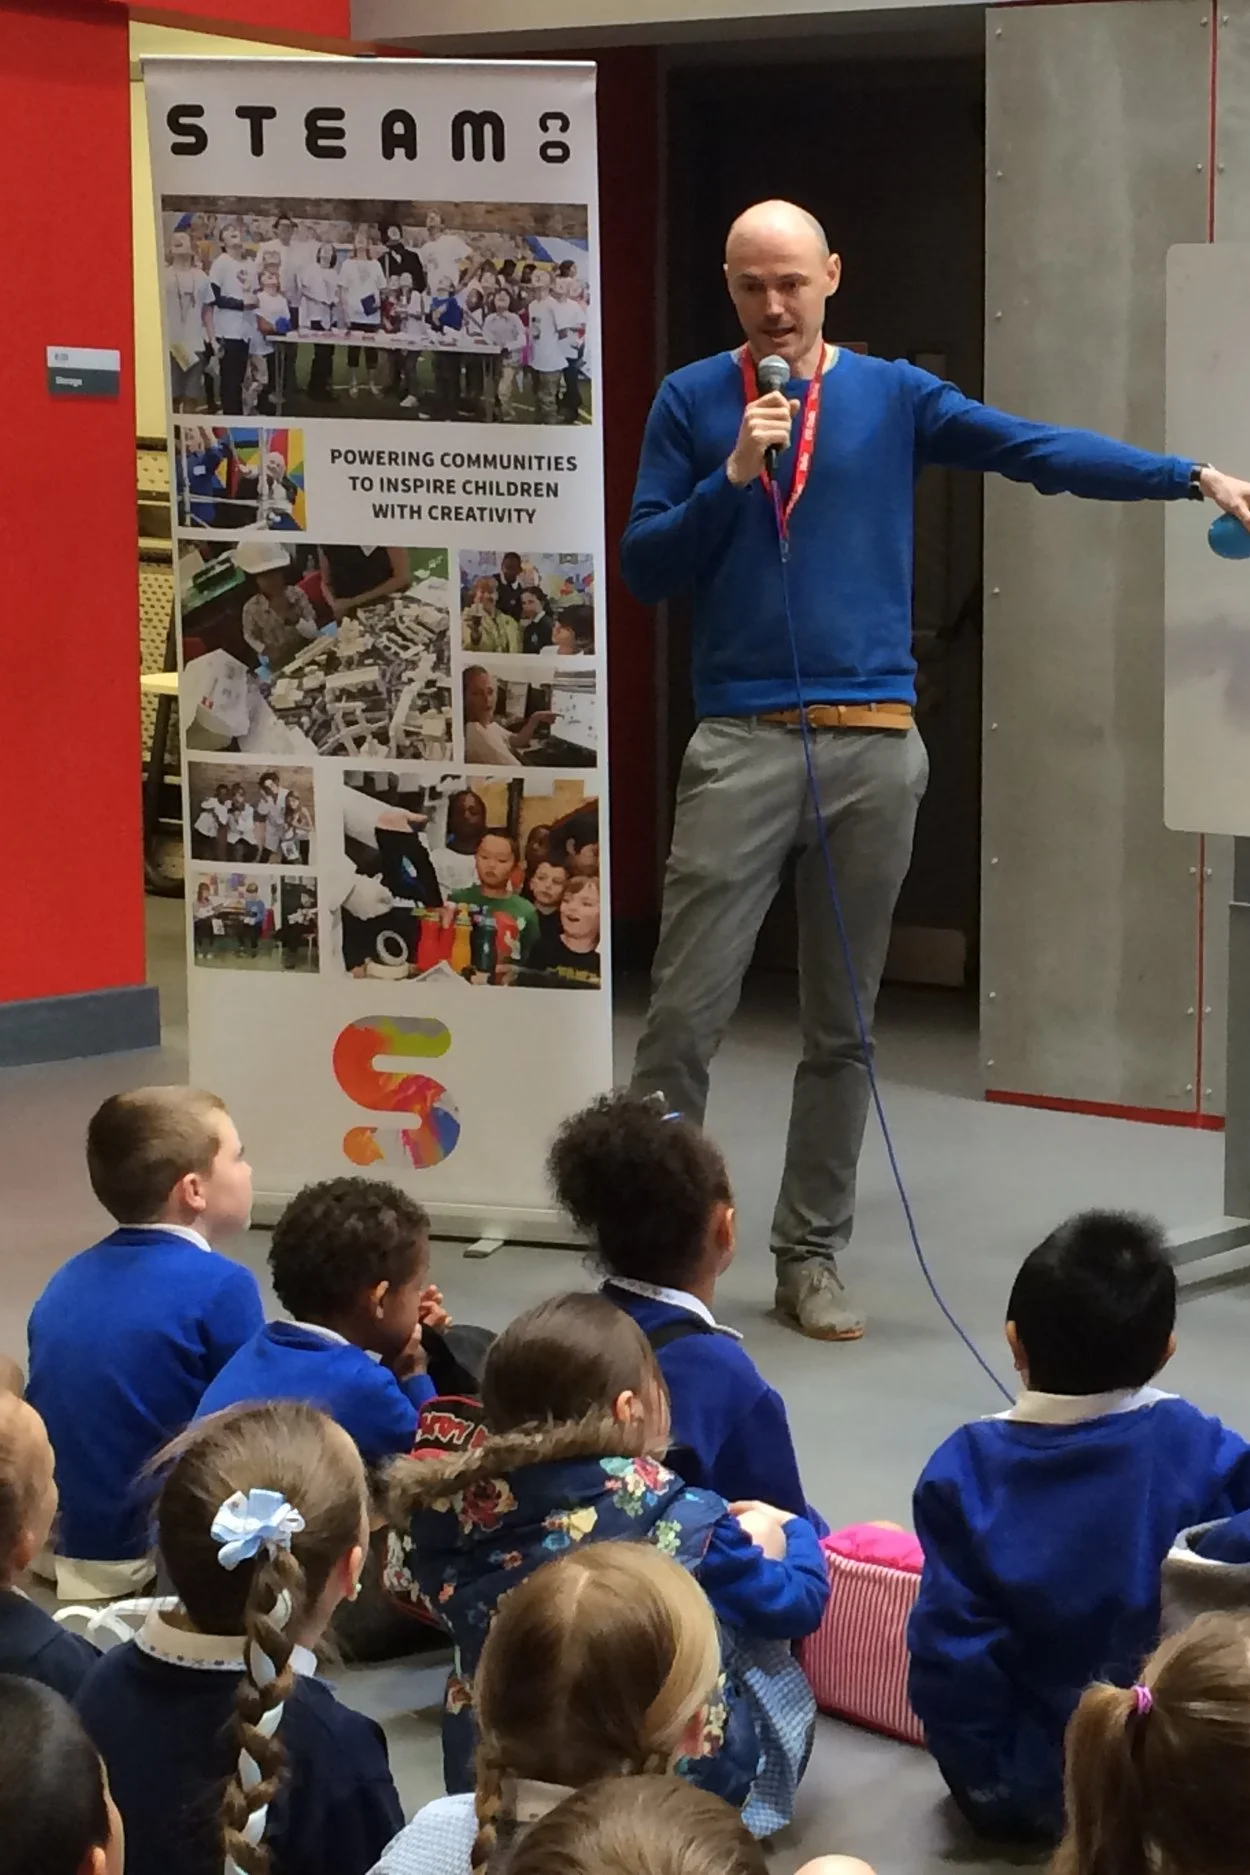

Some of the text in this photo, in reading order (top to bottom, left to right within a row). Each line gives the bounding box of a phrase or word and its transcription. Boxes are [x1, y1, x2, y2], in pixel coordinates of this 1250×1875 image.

[166, 104, 505, 162] STEAM
[330, 449, 578, 471] POWERING COMMUNITIES
[348, 476, 559, 498] TO INSPIRE CHILDREN
[371, 503, 537, 524] WITH CREATIVITY
